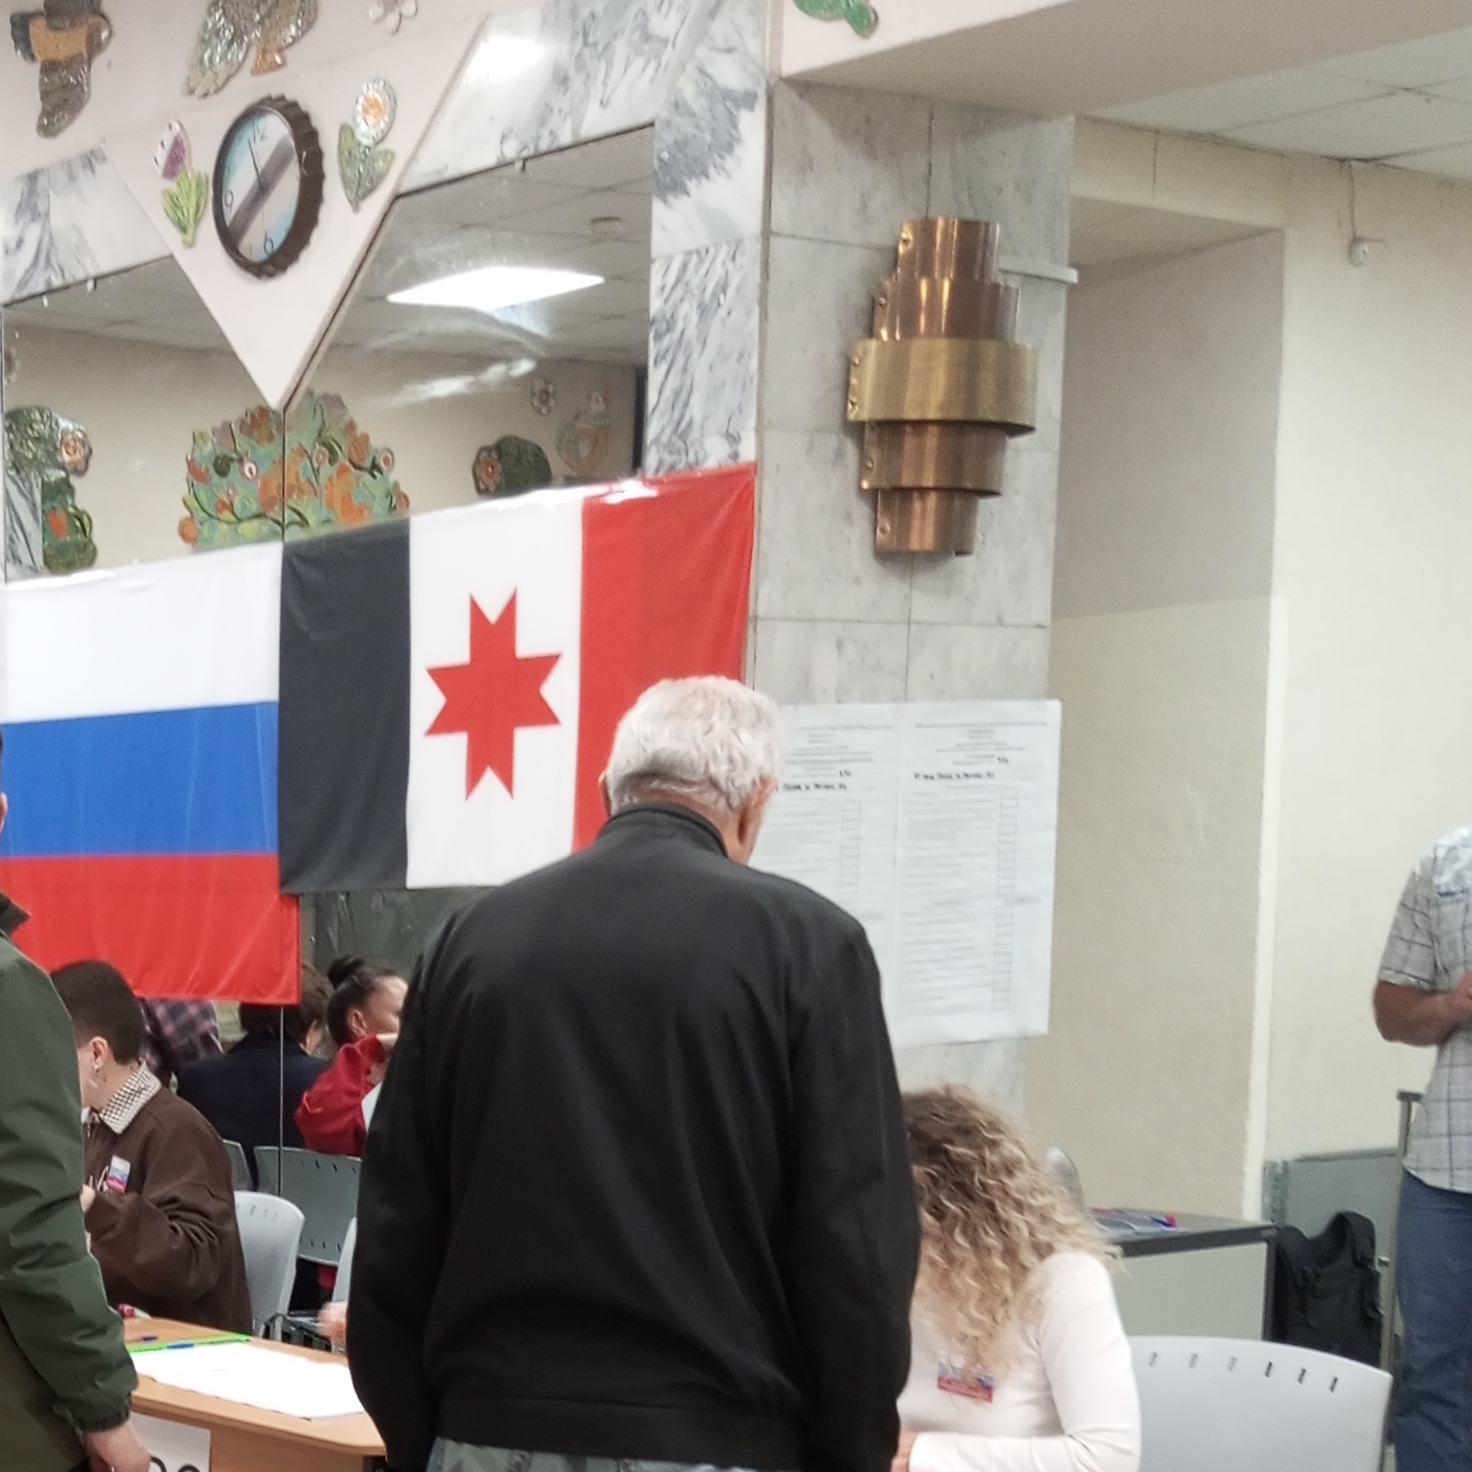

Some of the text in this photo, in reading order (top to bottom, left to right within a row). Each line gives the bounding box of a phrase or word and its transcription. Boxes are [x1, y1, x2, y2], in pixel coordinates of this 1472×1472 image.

[252, 117, 268, 143] 12
[224, 190, 234, 213] 9
[263, 230, 275, 255] 6
